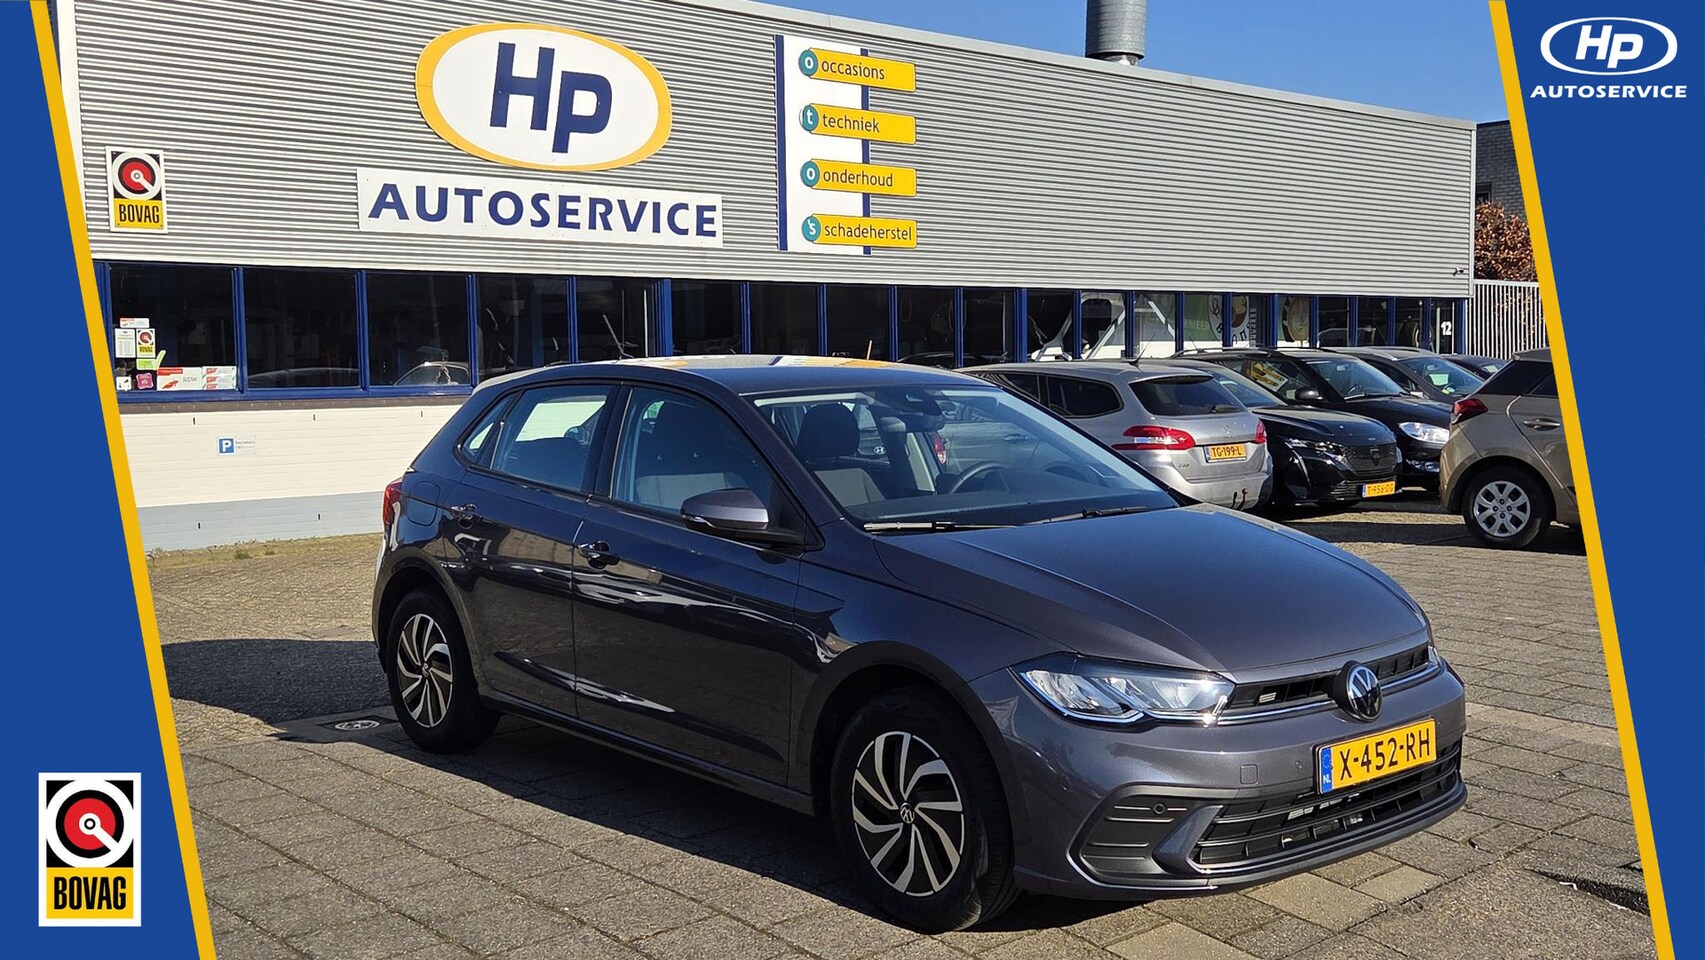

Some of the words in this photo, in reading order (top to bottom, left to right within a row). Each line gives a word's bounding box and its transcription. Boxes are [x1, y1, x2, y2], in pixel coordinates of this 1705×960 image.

[821, 58, 885, 80] occasions
[490, 42, 612, 154] Hp
[822, 113, 880, 133] techniek
[823, 169, 893, 187] onderhoud
[118, 203, 160, 224] BOVAG
[368, 183, 717, 238] AUTOSERVICE
[824, 222, 912, 241] schadeherstel
[1440, 321, 1452, 336] 12
[1211, 445, 1242, 457] TG-199-L
[1322, 774, 1332, 784] NL
[1340, 728, 1431, 781] X-452-RH
